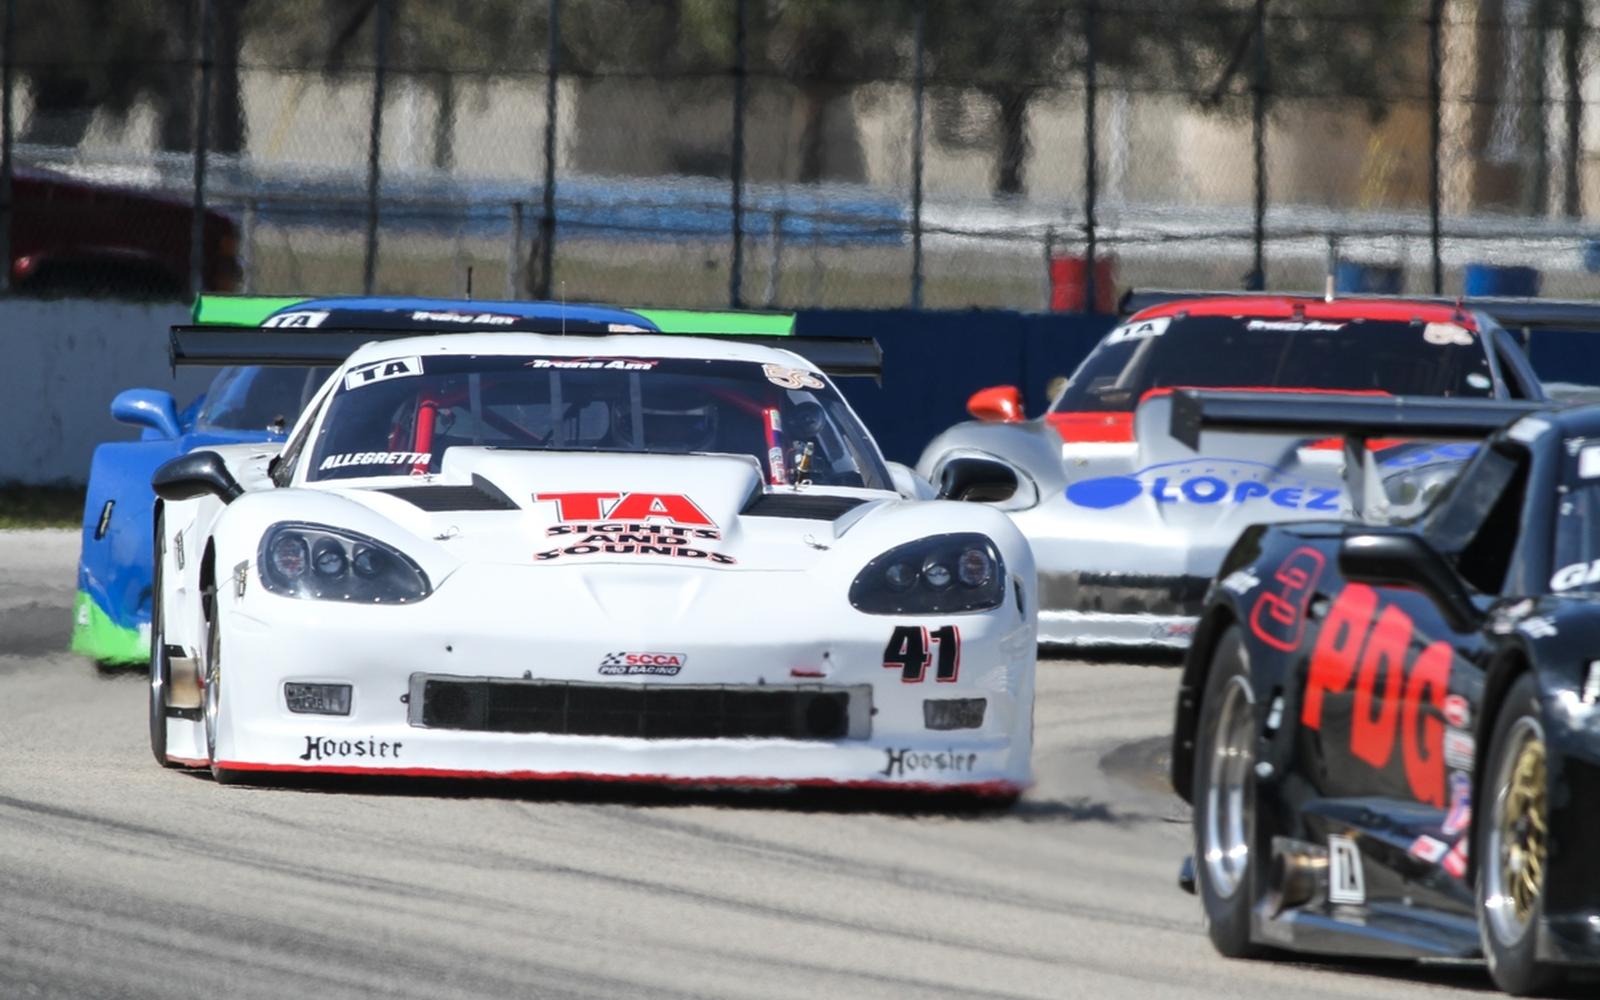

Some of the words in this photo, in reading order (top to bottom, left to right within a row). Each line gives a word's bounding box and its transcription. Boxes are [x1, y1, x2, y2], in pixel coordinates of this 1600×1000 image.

[356, 360, 410, 382] TA
[532, 359, 603, 369] Trans
[604, 360, 653, 370] Am
[319, 452, 432, 470] ALLEGRETTA
[531, 491, 721, 528] TA
[545, 523, 721, 540] SIGHTS
[575, 534, 691, 546] AND
[533, 544, 738, 565] SOUNDS
[625, 653, 681, 667] SCCA
[882, 624, 961, 683] 41
[600, 665, 626, 675] PRO
[628, 665, 678, 676] RACING
[299, 735, 403, 761] Hoosier
